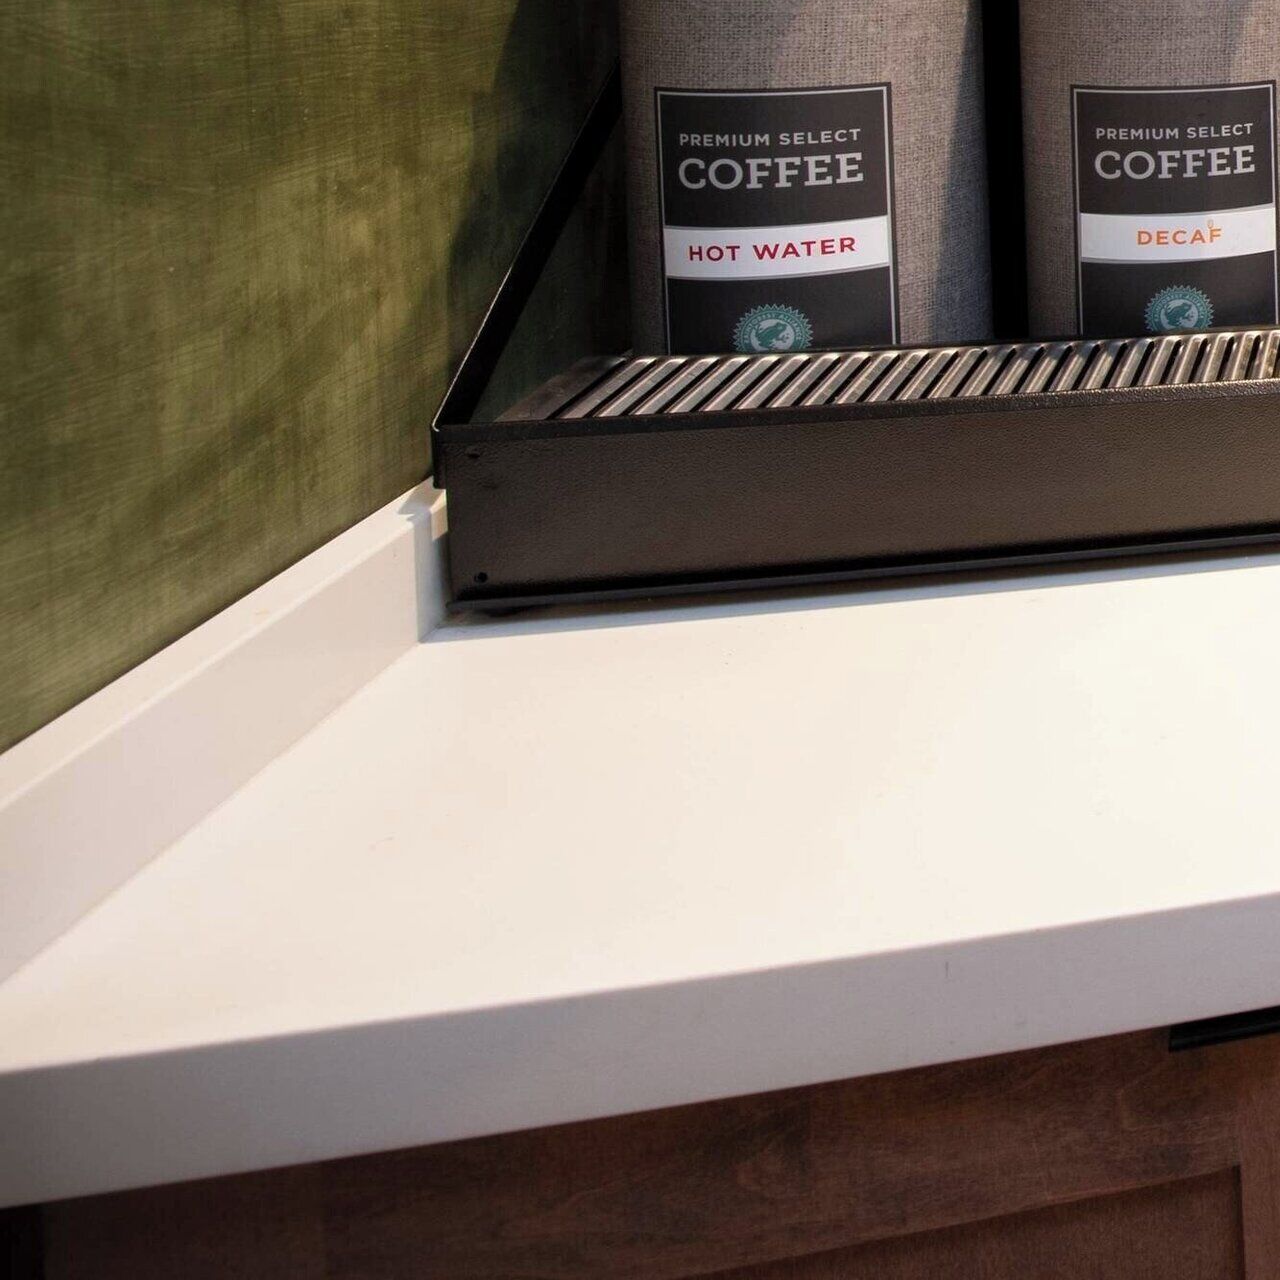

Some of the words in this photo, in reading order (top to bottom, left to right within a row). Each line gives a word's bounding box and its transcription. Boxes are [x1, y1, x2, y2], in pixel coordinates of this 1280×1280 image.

[679, 132, 770, 148] PREMIUM
[779, 128, 861, 146] SELECT
[1095, 127, 1179, 140] PREMIUM
[1186, 123, 1254, 139] SELECT
[678, 151, 864, 190] COFFEE
[1094, 144, 1256, 180] COFFEE
[1137, 227, 1222, 246] DECAF
[689, 245, 741, 262] HOT
[752, 237, 856, 261] WATER
